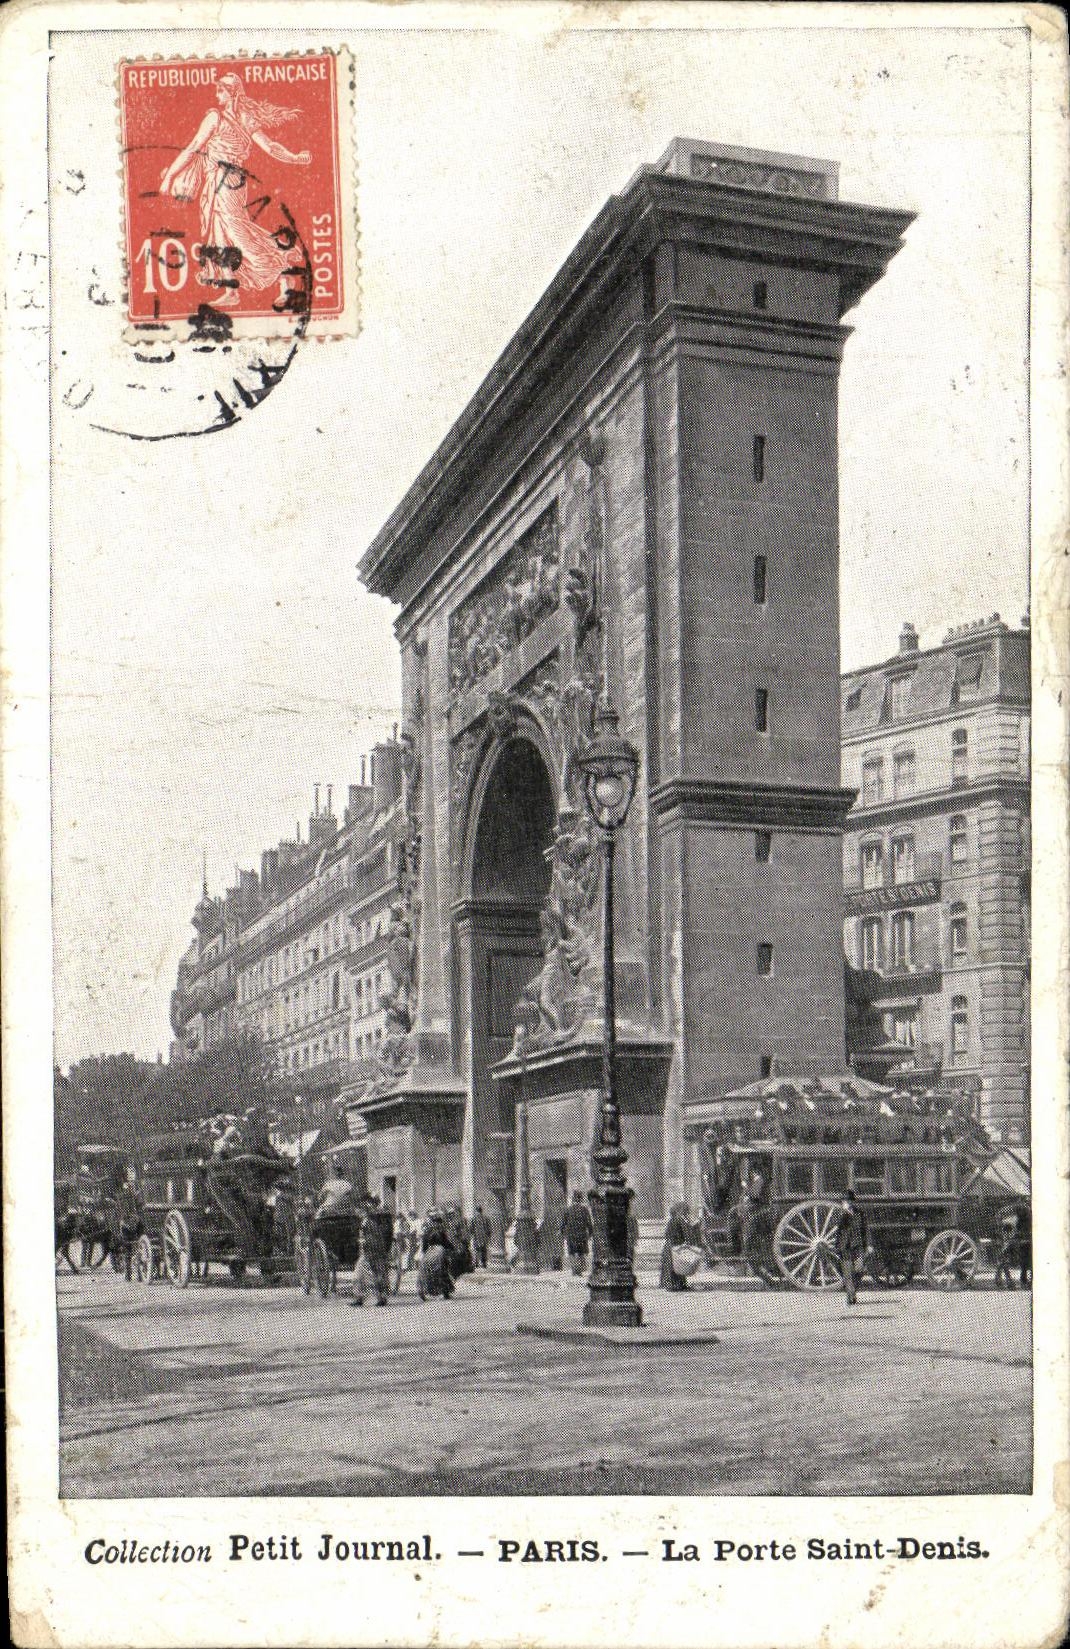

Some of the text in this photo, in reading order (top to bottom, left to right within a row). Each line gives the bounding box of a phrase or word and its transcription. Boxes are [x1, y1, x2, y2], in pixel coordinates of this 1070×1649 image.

[128, 62, 328, 88] REPUBLIQUE FRANÇAISE
[312, 212, 334, 299] POSTES
